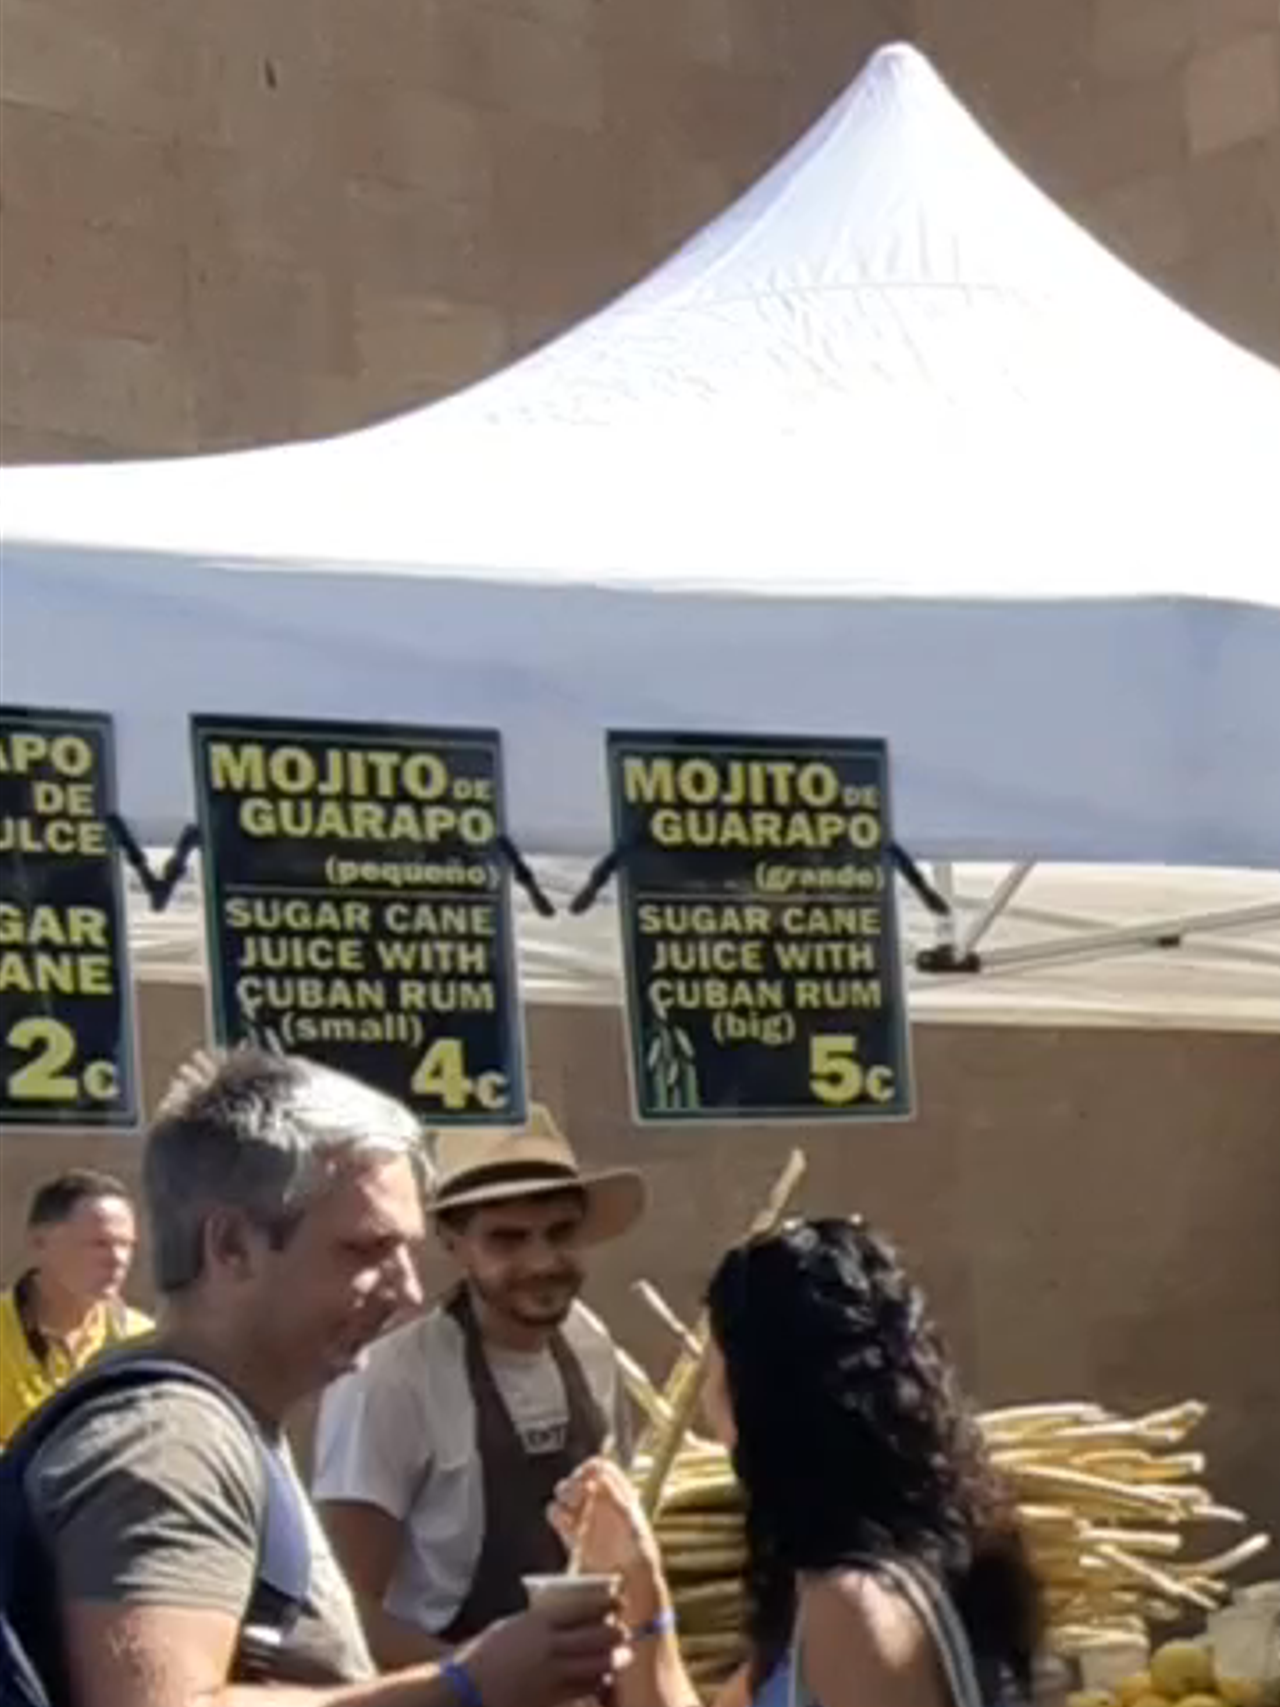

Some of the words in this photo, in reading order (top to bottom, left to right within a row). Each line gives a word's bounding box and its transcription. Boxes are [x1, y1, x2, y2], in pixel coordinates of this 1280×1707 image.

[209, 744, 448, 800] MOJITO
[452, 778, 494, 802] DE
[623, 756, 839, 807] MOJITO
[843, 786, 879, 809] DE
[34, 781, 96, 817] DE
[239, 797, 495, 843] GUARAPO
[650, 808, 880, 849] GUARAPO
[224, 897, 371, 932] SUGAR
[384, 904, 496, 935] CANE
[638, 904, 771, 934] SUGAR
[782, 907, 881, 935] CANE
[239, 936, 365, 970] JUICE
[377, 940, 487, 972] WITH
[651, 942, 764, 971] JUICE
[774, 942, 875, 971] WITH
[236, 976, 385, 1010] CUBAN
[401, 981, 495, 1010] RUM
[649, 979, 783, 1010] CUBAN
[795, 979, 882, 1009] RUM
[281, 1012, 424, 1046] (small)
[712, 1011, 796, 1044] (big)
